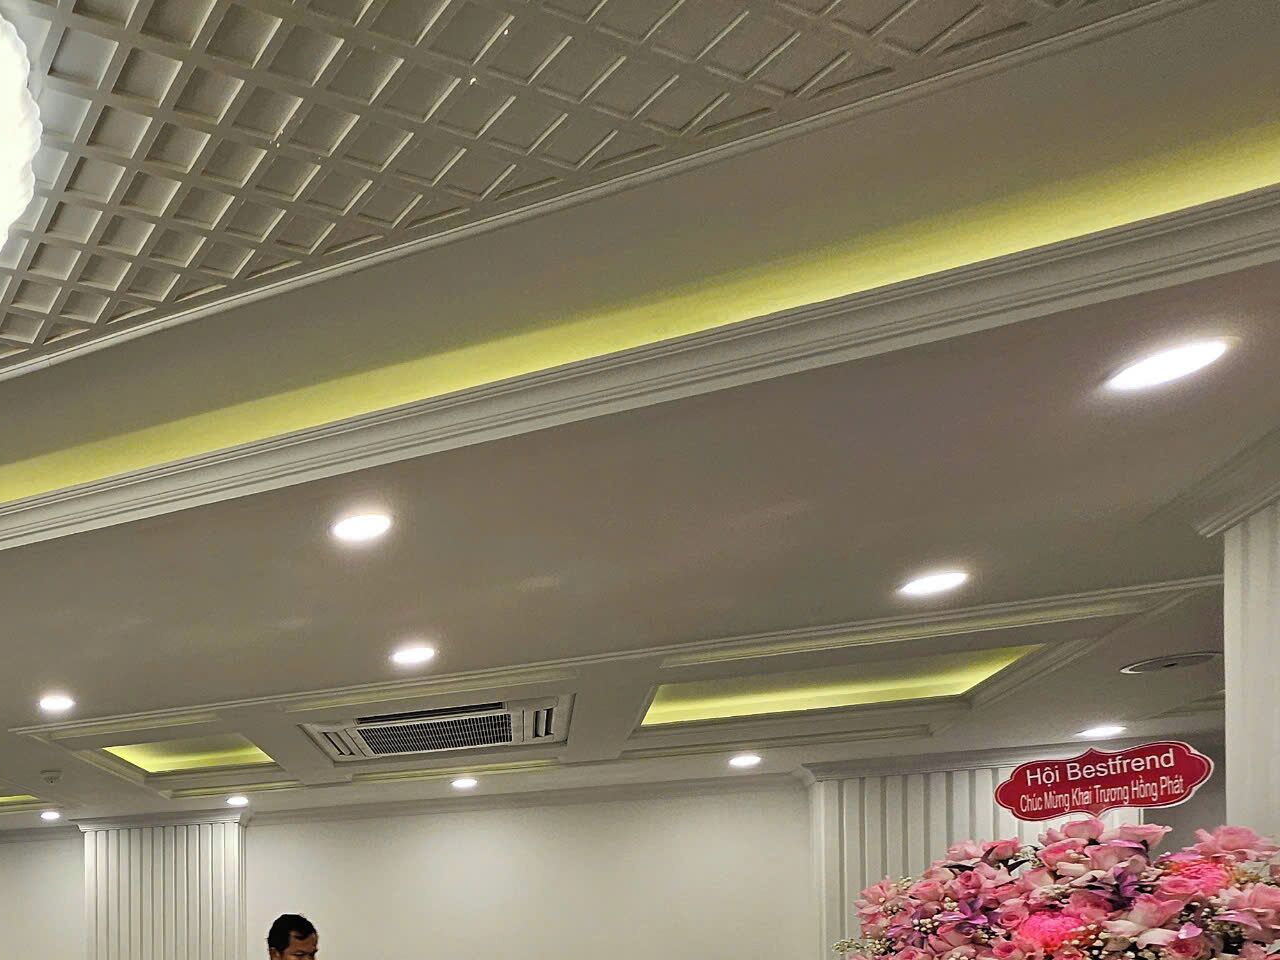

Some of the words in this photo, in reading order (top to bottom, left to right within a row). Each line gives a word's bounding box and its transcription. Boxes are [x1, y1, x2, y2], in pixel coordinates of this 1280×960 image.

[1026, 765, 1060, 788] Hội
[1066, 749, 1175, 781] Bestfrend
[1020, 793, 1043, 812] Chúc
[1044, 790, 1070, 811] Mừng
[1071, 786, 1092, 806] Khai
[1094, 784, 1129, 805] Trương
[1131, 775, 1158, 801] Hồng
[1160, 774, 1184, 795] Phát
